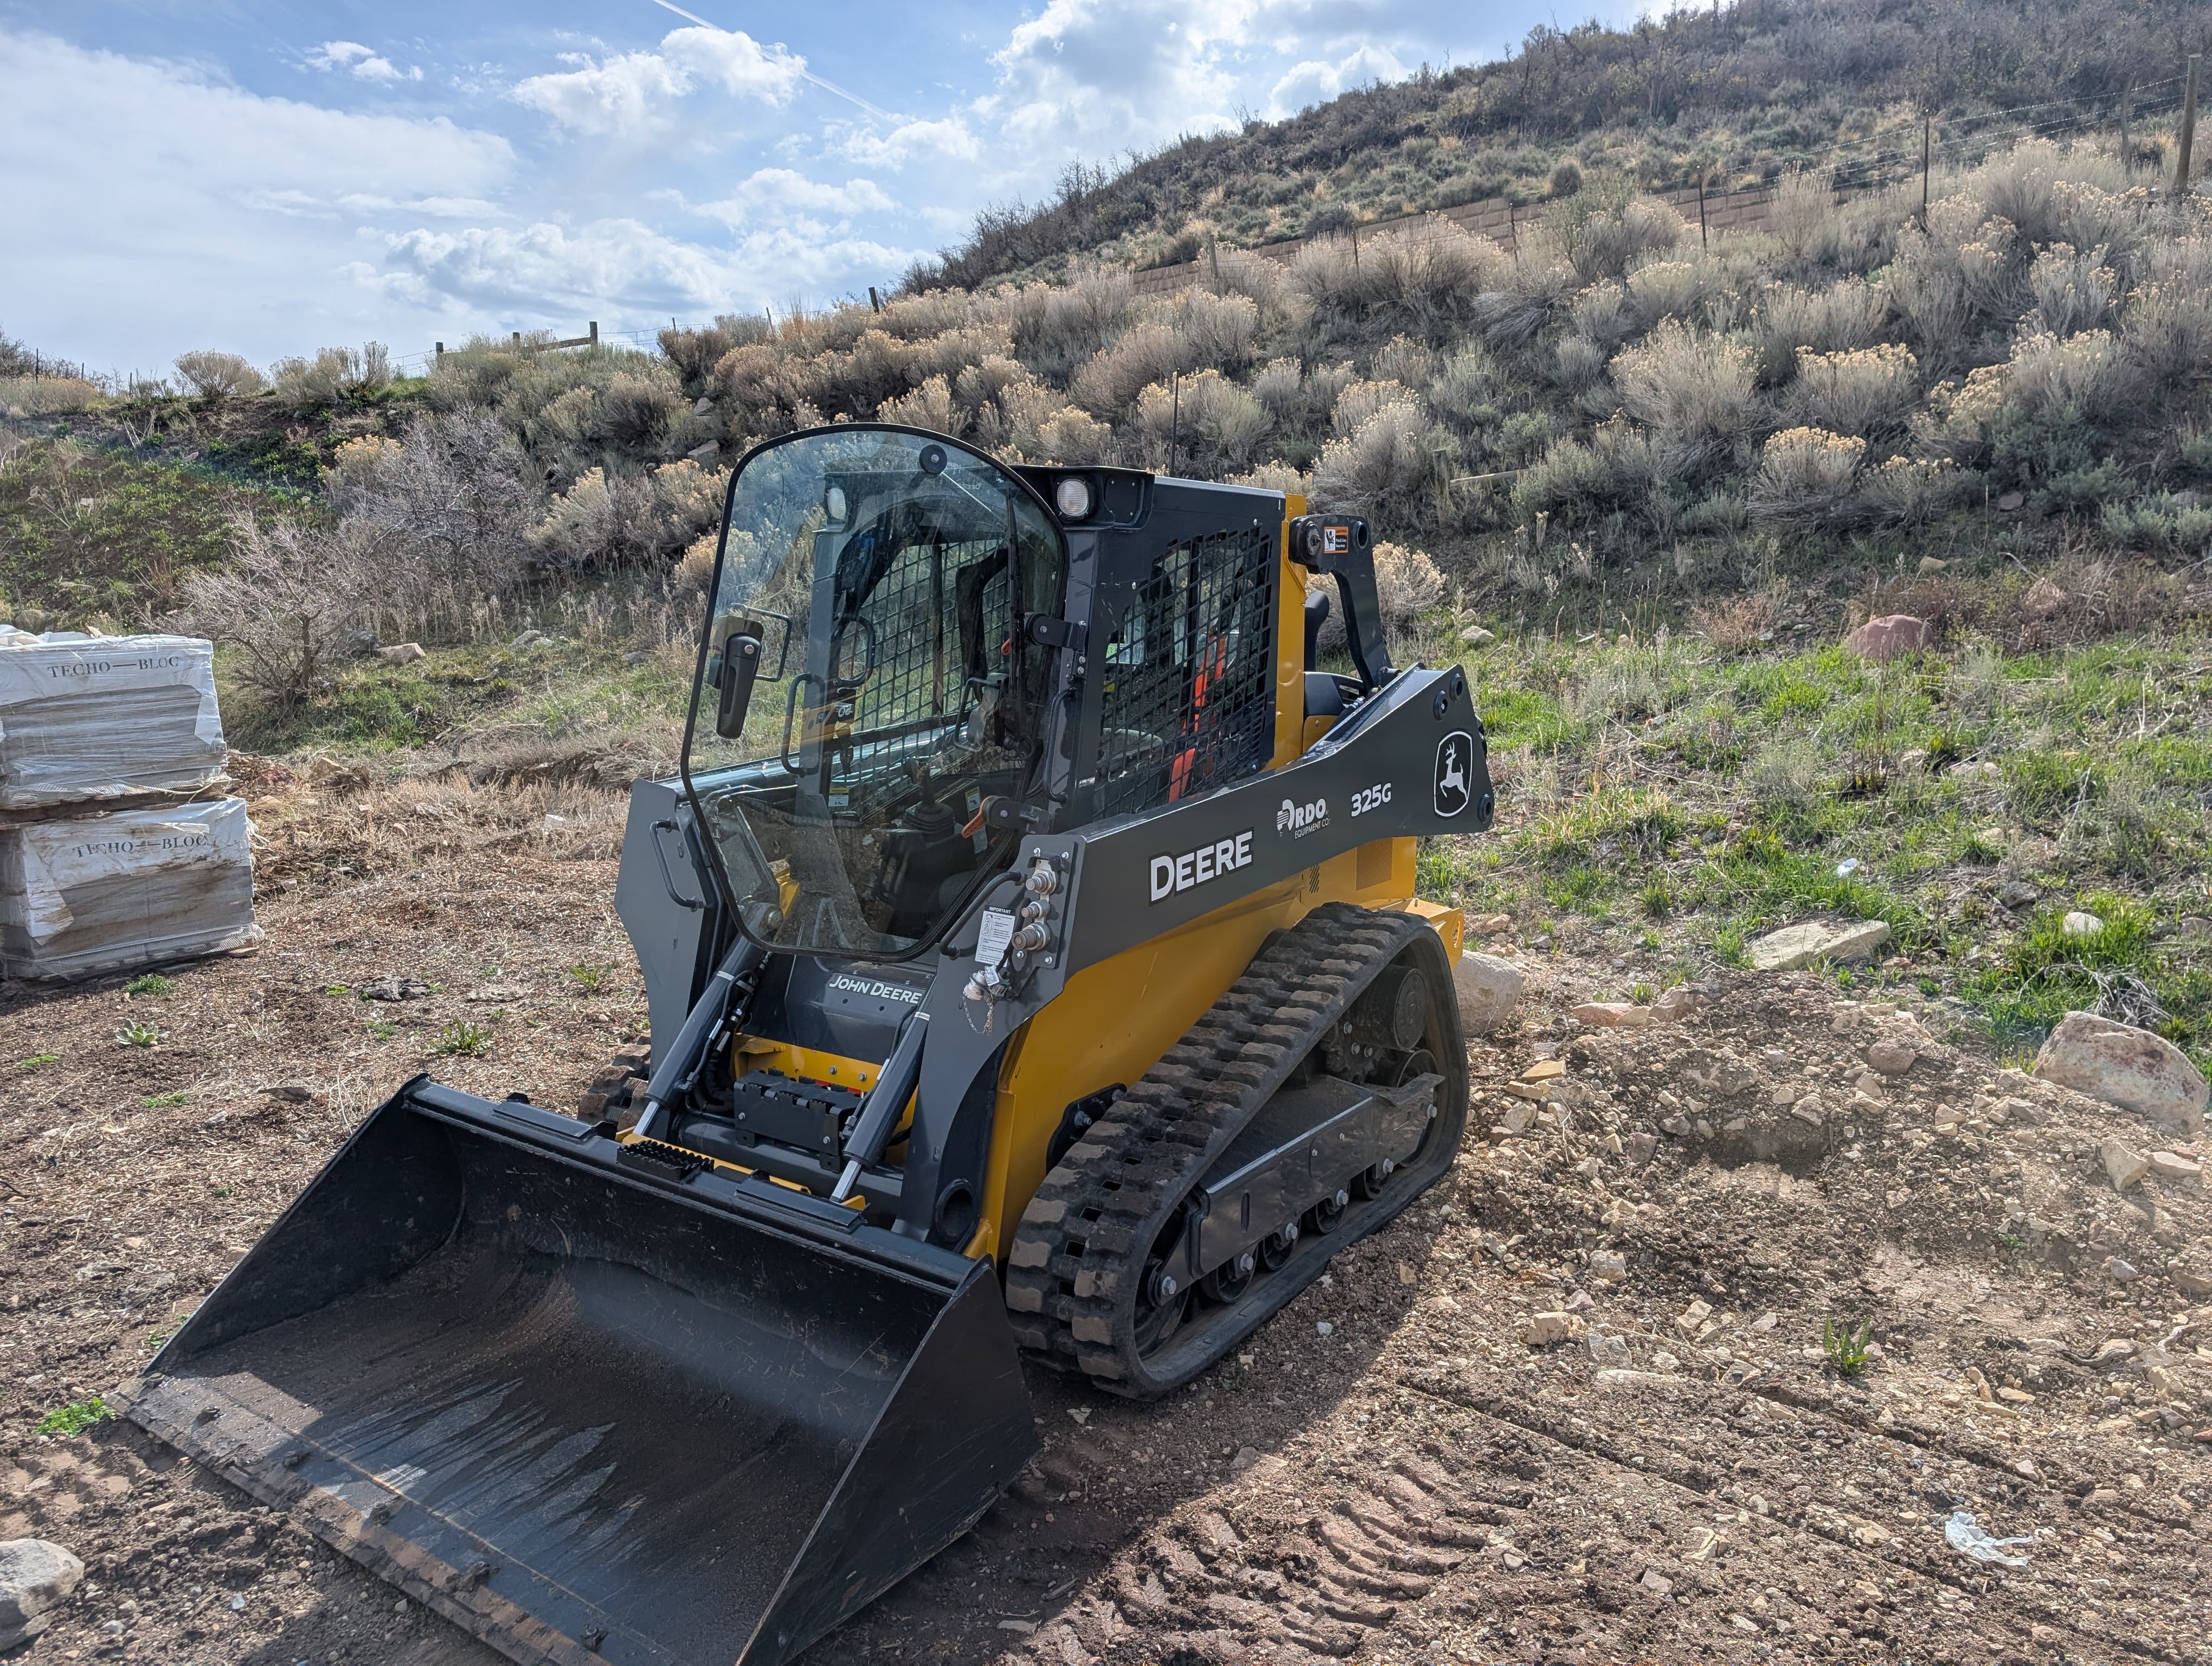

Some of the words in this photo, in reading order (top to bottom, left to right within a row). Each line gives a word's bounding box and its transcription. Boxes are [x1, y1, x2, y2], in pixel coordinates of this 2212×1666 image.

[1351, 783, 1391, 817] 325G
[1295, 821, 1321, 840] EQUIPMENT
[1150, 831, 1252, 902] DEERE
[989, 906, 1012, 914] IMPORTANT
[829, 976, 871, 994] JOHN
[870, 982, 922, 1004] DEERE
